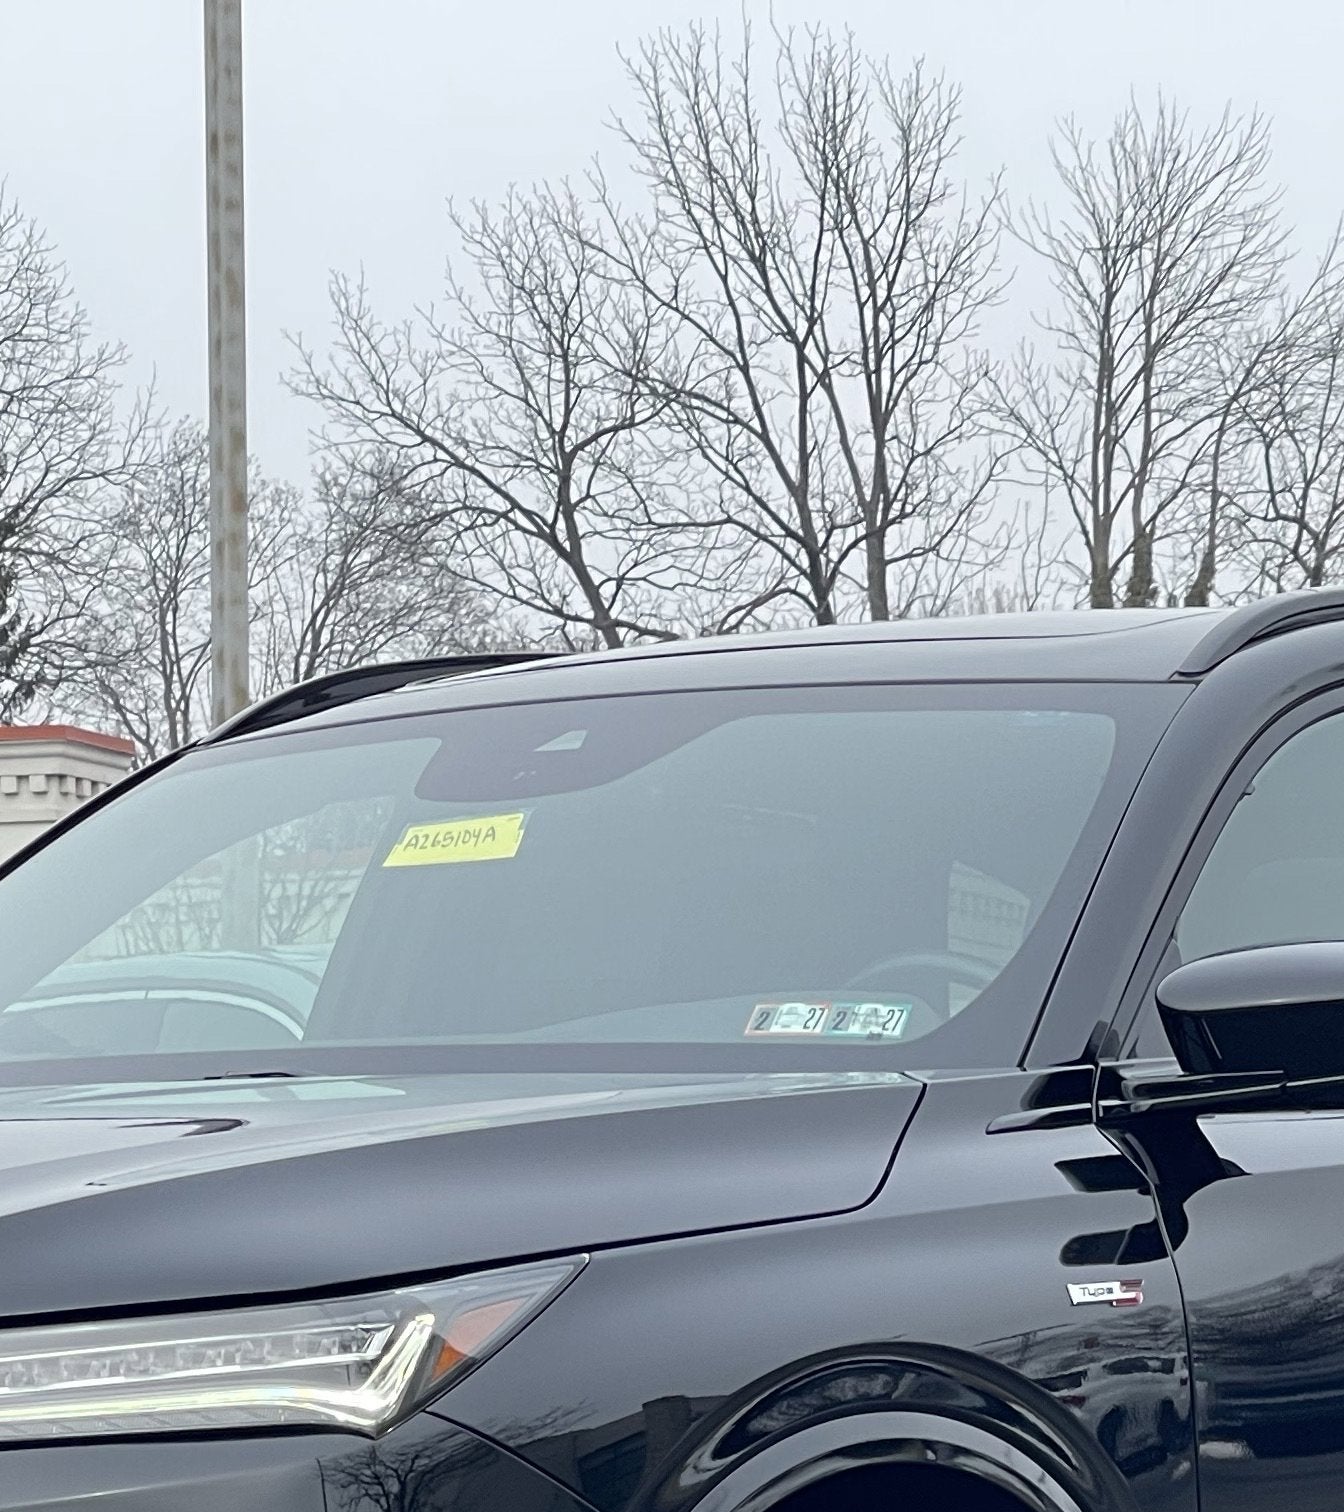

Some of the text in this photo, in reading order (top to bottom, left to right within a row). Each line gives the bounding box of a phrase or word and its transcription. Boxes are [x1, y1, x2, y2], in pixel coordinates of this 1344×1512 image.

[753, 1007, 826, 1031] 2 27
[831, 1009, 905, 1032] 2 27
